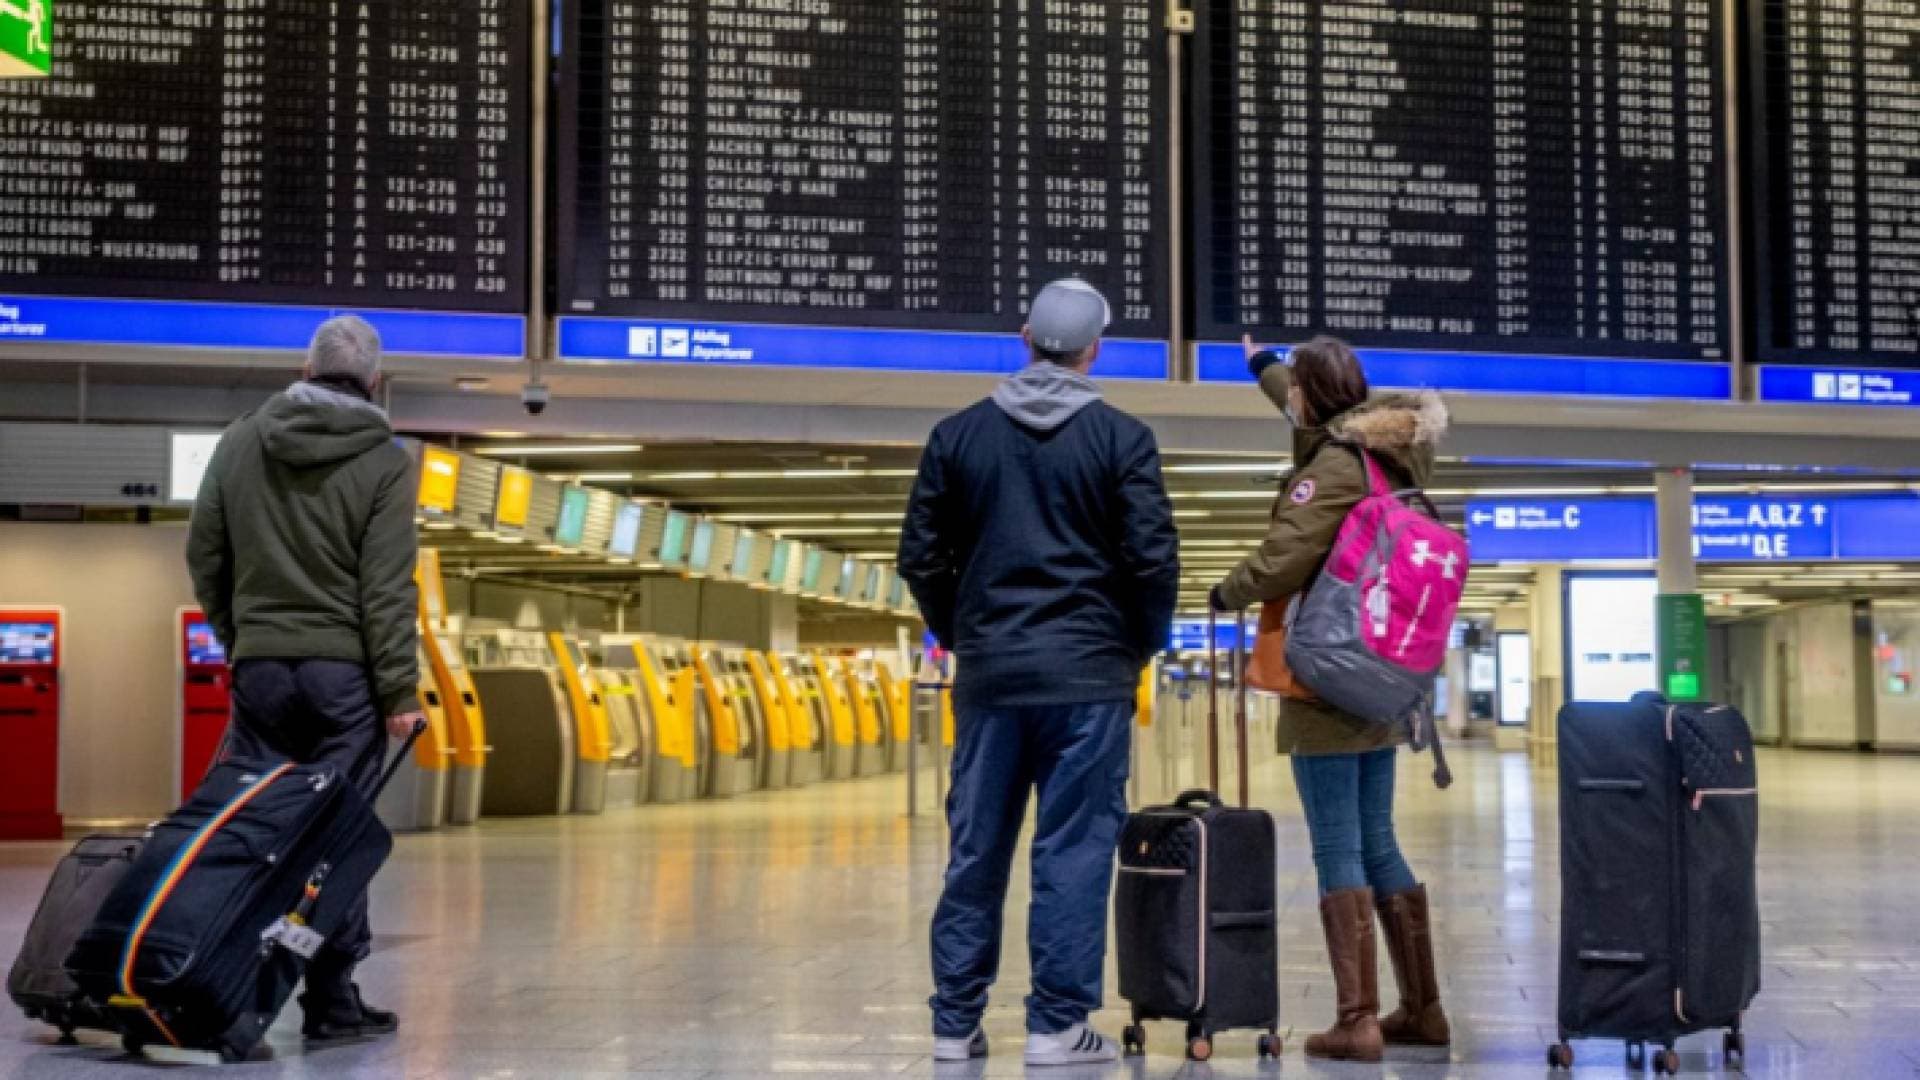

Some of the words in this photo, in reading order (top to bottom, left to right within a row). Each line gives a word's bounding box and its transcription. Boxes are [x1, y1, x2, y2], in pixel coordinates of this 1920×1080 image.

[612, 3, 633, 18] LH
[612, 23, 633, 36] LH
[612, 40, 633, 55] LH
[707, 47, 737, 63] LOS
[612, 59, 633, 74] LH
[707, 64, 773, 84] SEATTLE
[612, 96, 632, 111] LH
[612, 115, 632, 130] LH
[611, 134, 631, 147] LH
[706, 139, 765, 155] AACHEN
[706, 156, 809, 176] DALLAS-FORT
[819, 164, 865, 179] WORTH
[610, 171, 630, 185] LH
[799, 181, 836, 198] HARE
[610, 189, 630, 204] LH
[706, 193, 765, 211] CANCUN
[609, 209, 630, 222] LH
[610, 227, 630, 241] LH
[609, 246, 630, 260] LH
[706, 250, 838, 269] LEIPZIG-ERFURT
[609, 264, 630, 279] LH
[706, 285, 865, 308] WASHINGTON-DULLES
[1439, 318, 1473, 333] POLO
[1564, 504, 1581, 530] C
